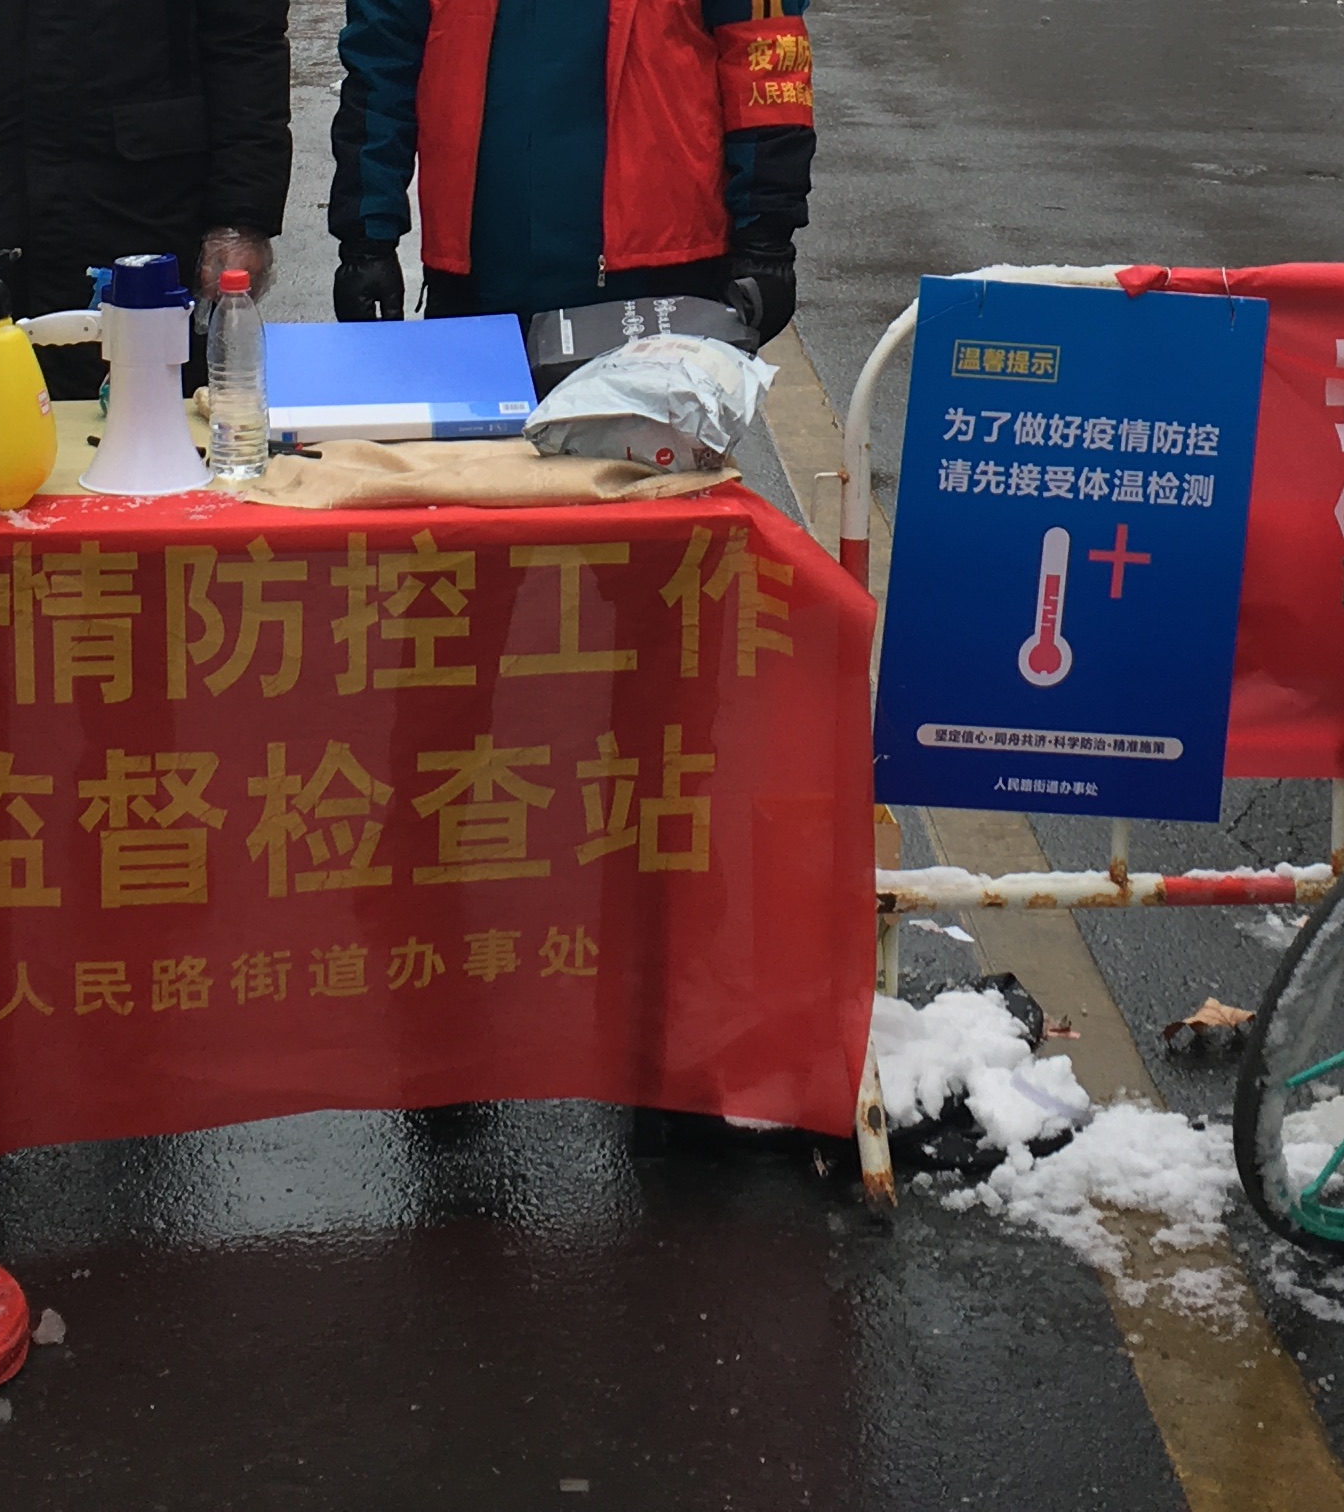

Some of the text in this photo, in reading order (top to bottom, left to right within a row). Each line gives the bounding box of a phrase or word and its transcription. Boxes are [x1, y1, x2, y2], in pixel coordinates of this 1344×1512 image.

[958, 346, 1054, 375] 温馨提示
[943, 407, 1220, 456] 为了做好疫情防控
[938, 459, 1214, 507] 请先接受体温检测
[994, 777, 1098, 796] 人民路街道办事处
